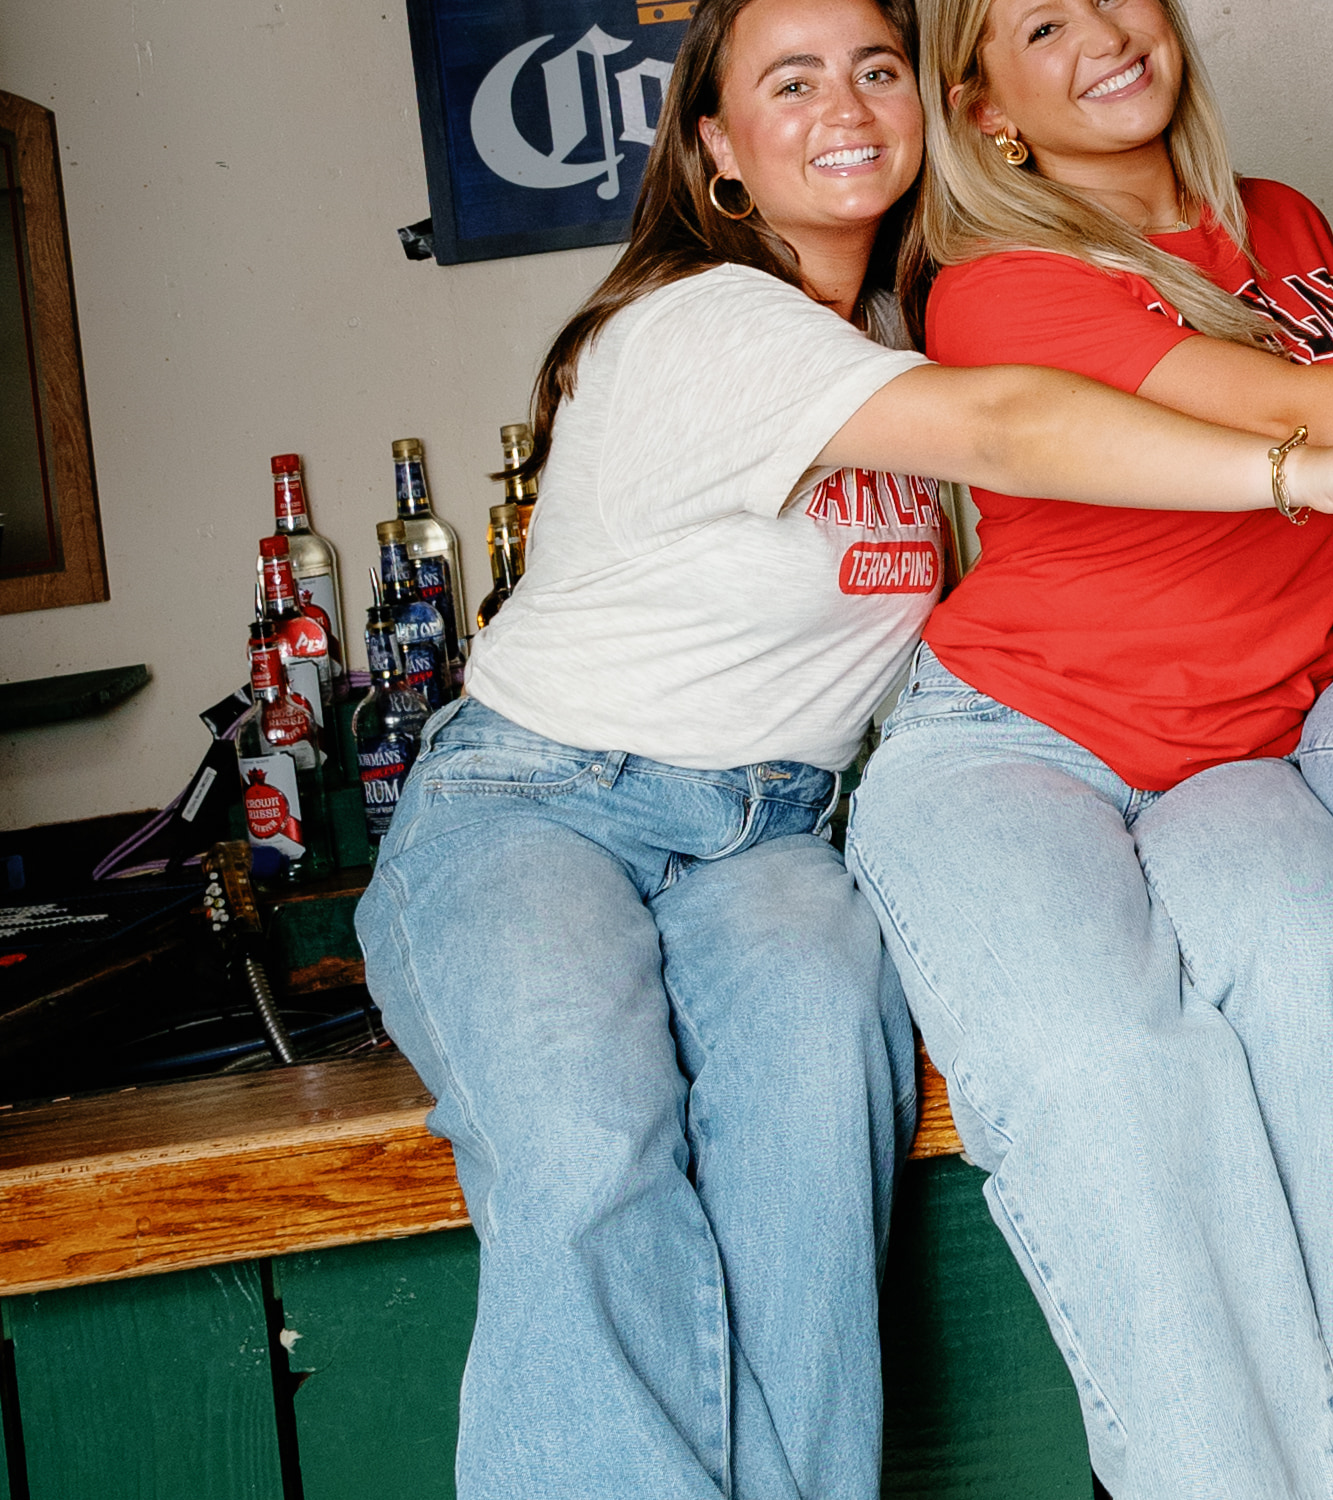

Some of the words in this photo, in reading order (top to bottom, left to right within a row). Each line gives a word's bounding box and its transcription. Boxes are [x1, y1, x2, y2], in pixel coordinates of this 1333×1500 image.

[848, 550, 934, 587] TERRAPINS
[246, 797, 280, 808] CROWN
[364, 779, 400, 803] RUM
